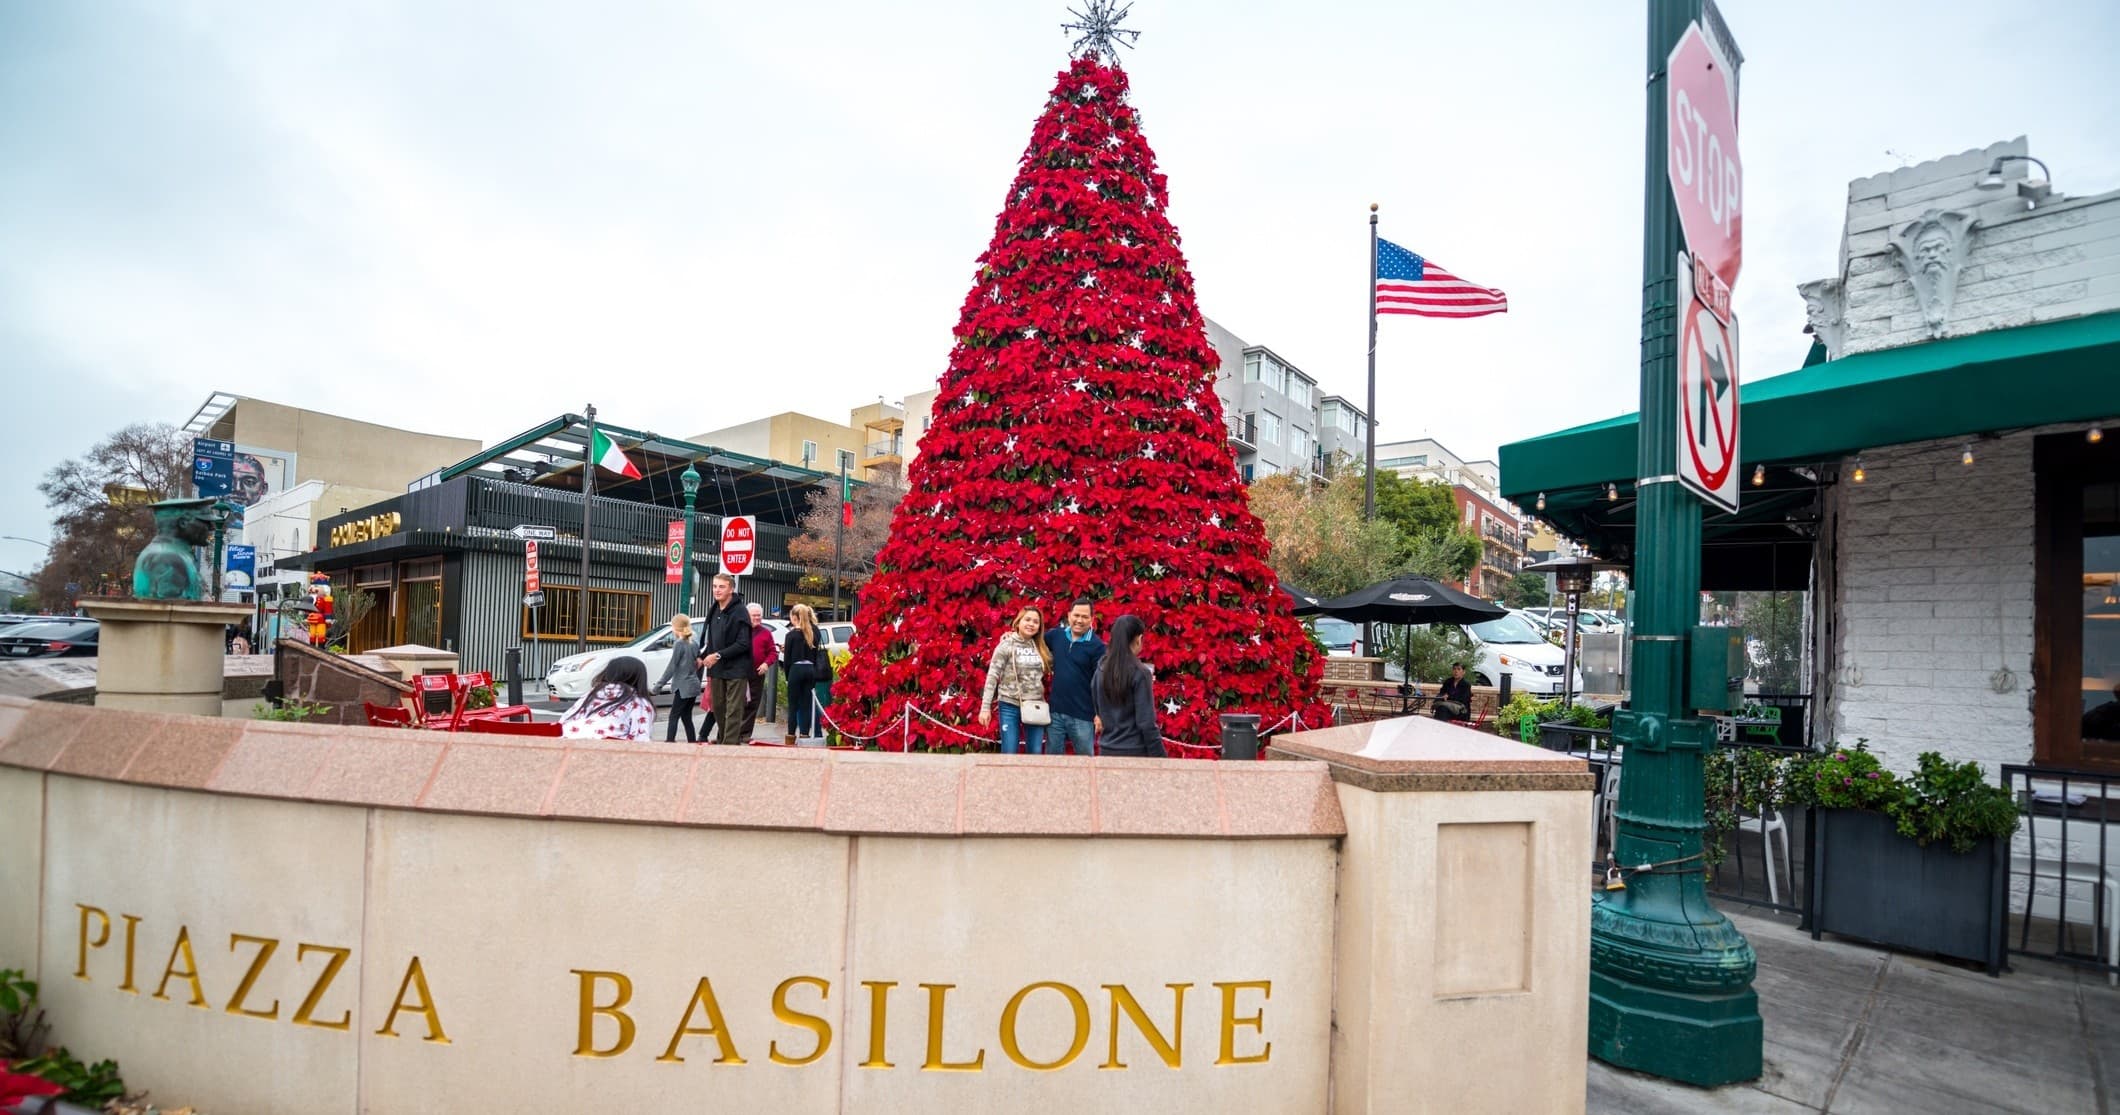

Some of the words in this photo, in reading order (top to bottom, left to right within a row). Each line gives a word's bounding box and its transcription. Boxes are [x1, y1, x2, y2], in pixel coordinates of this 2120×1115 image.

[1675, 89, 1739, 239] STOP
[726, 529, 734, 537] DO
[738, 528, 750, 537] NOT
[727, 554, 747, 563] ENTER
[1016, 647, 1037, 656] HOL
[72, 903, 453, 1045] PIAZZA
[569, 968, 1274, 1072] BASILONE
